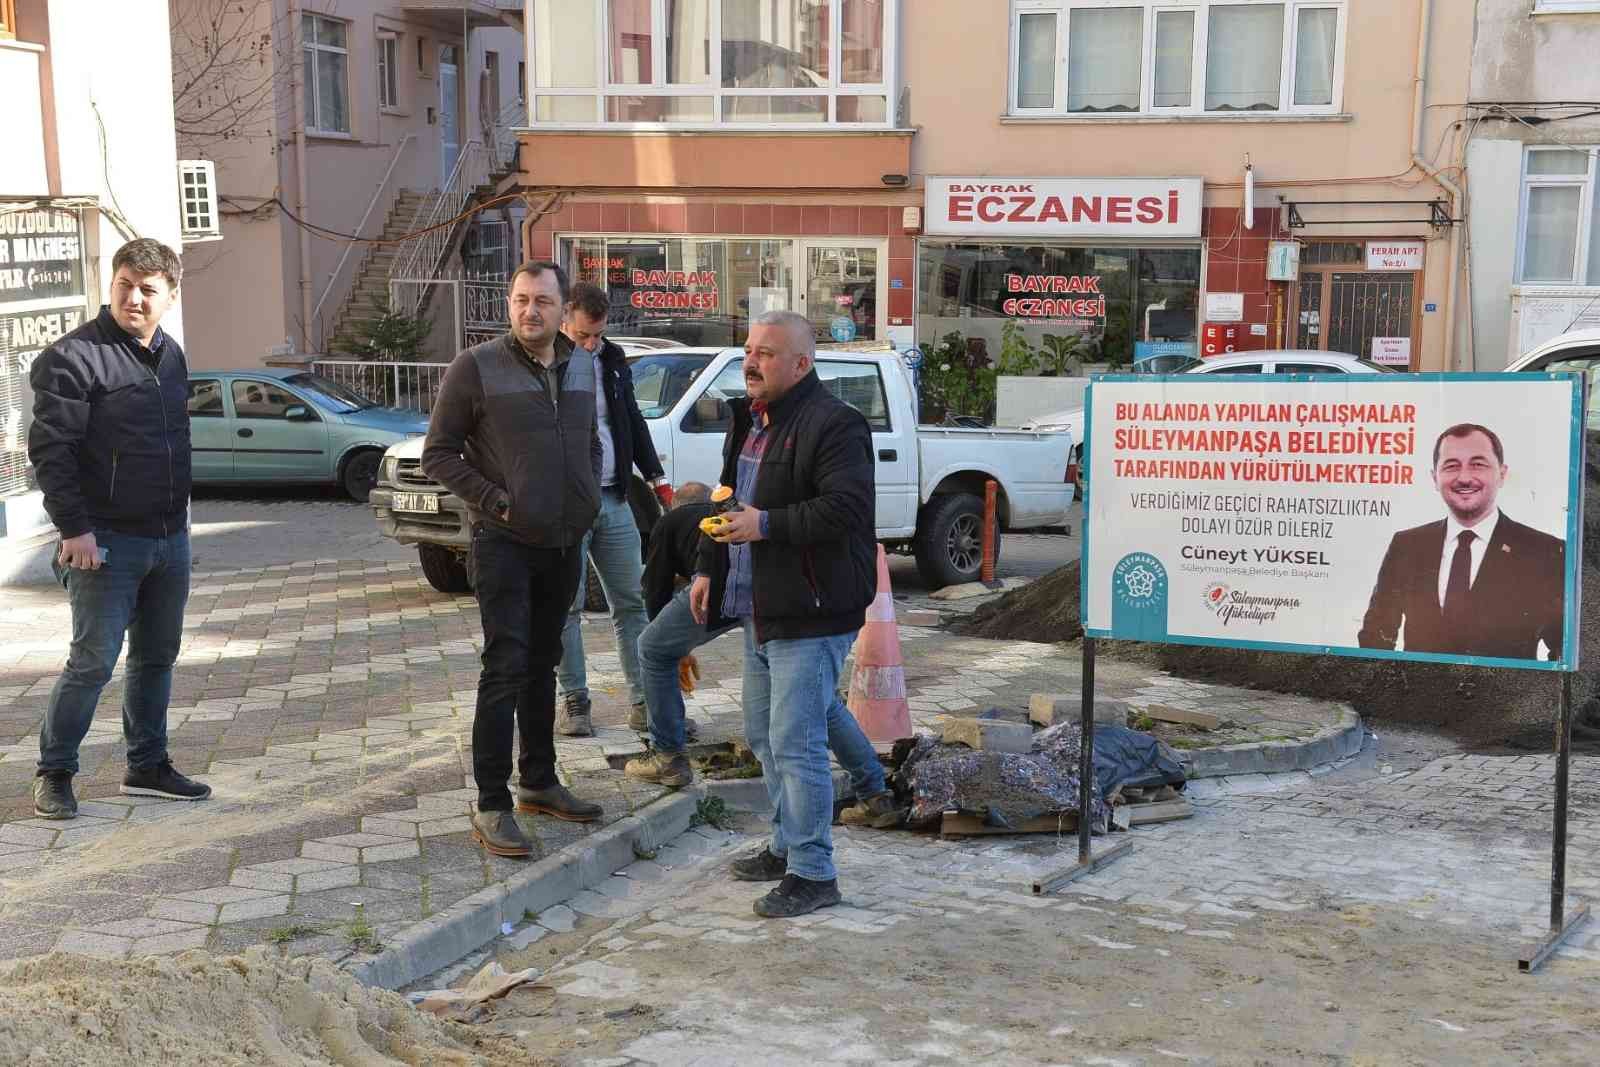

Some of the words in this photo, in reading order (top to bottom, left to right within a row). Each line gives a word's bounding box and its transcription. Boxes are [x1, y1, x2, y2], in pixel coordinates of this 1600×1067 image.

[949, 184, 1034, 193] BAYRAK
[948, 190, 1179, 224] ECZANESİ
[631, 269, 717, 287] BAYRAK
[1008, 275, 1101, 294] BAYRAK
[630, 287, 719, 310] ECZANESİ
[1003, 294, 1106, 317] ECZANESİ
[1116, 403, 1138, 421] BU
[1142, 403, 1210, 422] ALANDA
[1215, 404, 1291, 422] YAPILAN
[1296, 404, 1415, 427] ÇALIŞMALAR
[1114, 425, 1282, 457] SÜLEYMANPAŞA
[1288, 426, 1415, 455] BELEDİYESİ
[1114, 459, 1225, 480] TARAFINDAN
[1230, 458, 1414, 485] YÜRÜTÜLMEKTEDİR
[1131, 491, 1211, 511] VERDİĞİMİZ
[1214, 493, 1262, 515] GEÇİCİ
[1266, 497, 1391, 517] RAHATSIZLIKTAN
[1182, 517, 1231, 535] DOLAYI
[1235, 516, 1273, 537] ÖZÜR
[1278, 518, 1334, 539] DİLERİZ
[1181, 545, 1248, 564] Cüneyt
[1253, 546, 1330, 566] YÜKSEL
[1249, 567, 1289, 578] Belediye
[1216, 604, 1276, 627] Yükseliyor
